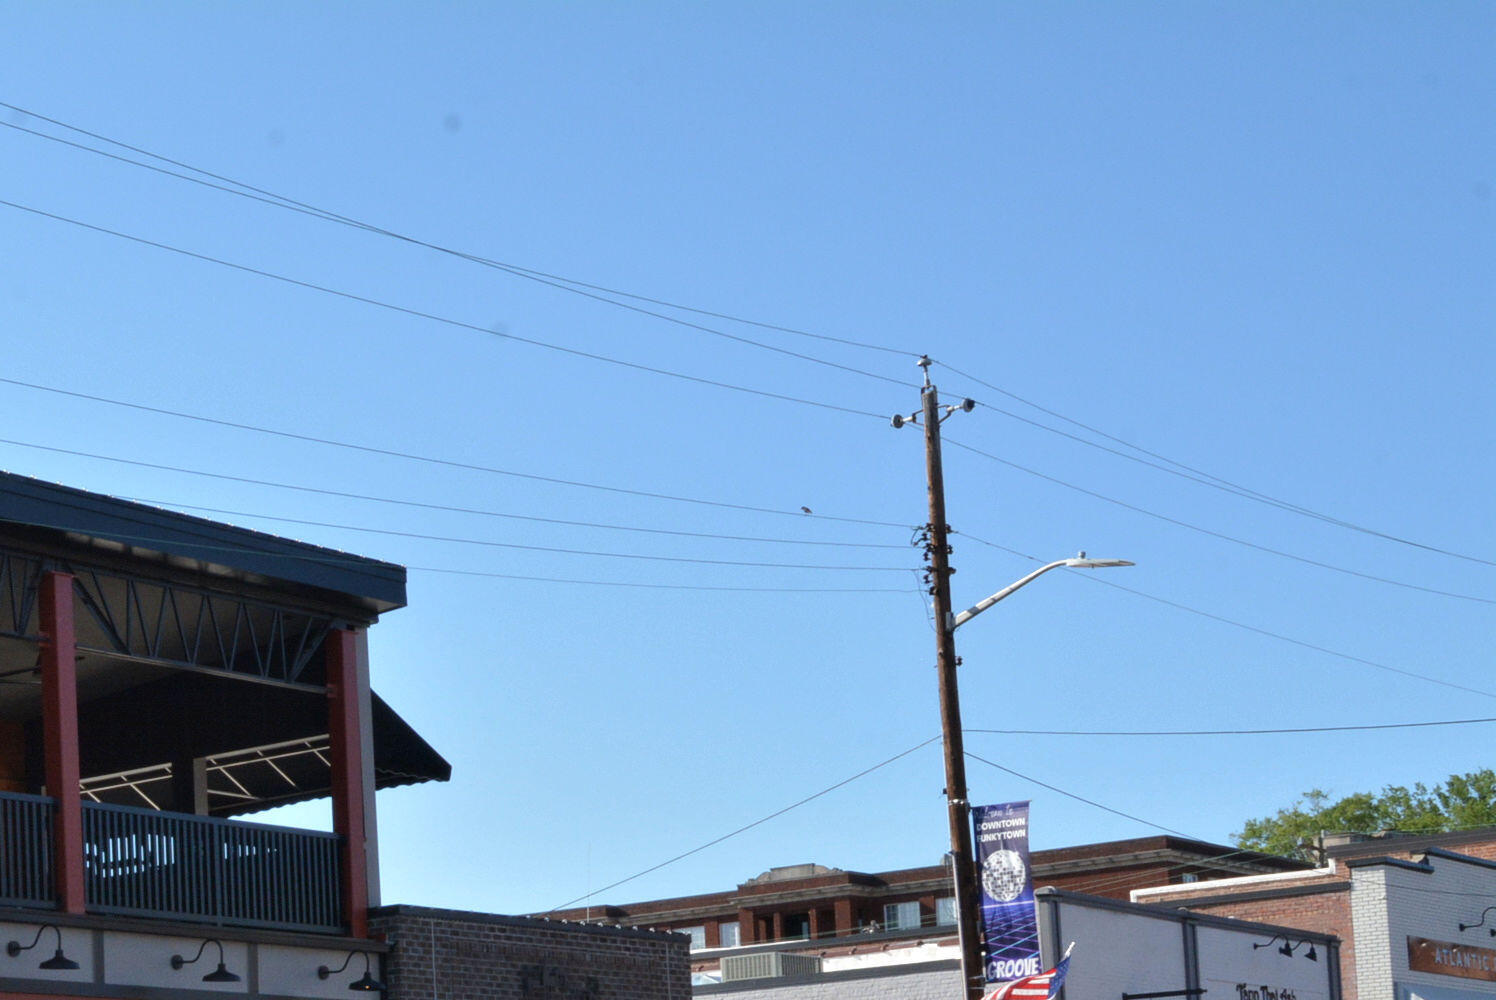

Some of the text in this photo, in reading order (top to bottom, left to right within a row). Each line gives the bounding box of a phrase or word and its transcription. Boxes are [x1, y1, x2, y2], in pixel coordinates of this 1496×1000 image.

[977, 817, 1026, 831] DOWNTOWN
[977, 829, 1026, 843] FUNKYTOWN
[987, 957, 1040, 981] GROOVE
[1434, 947, 1491, 972] ATLANTIC
